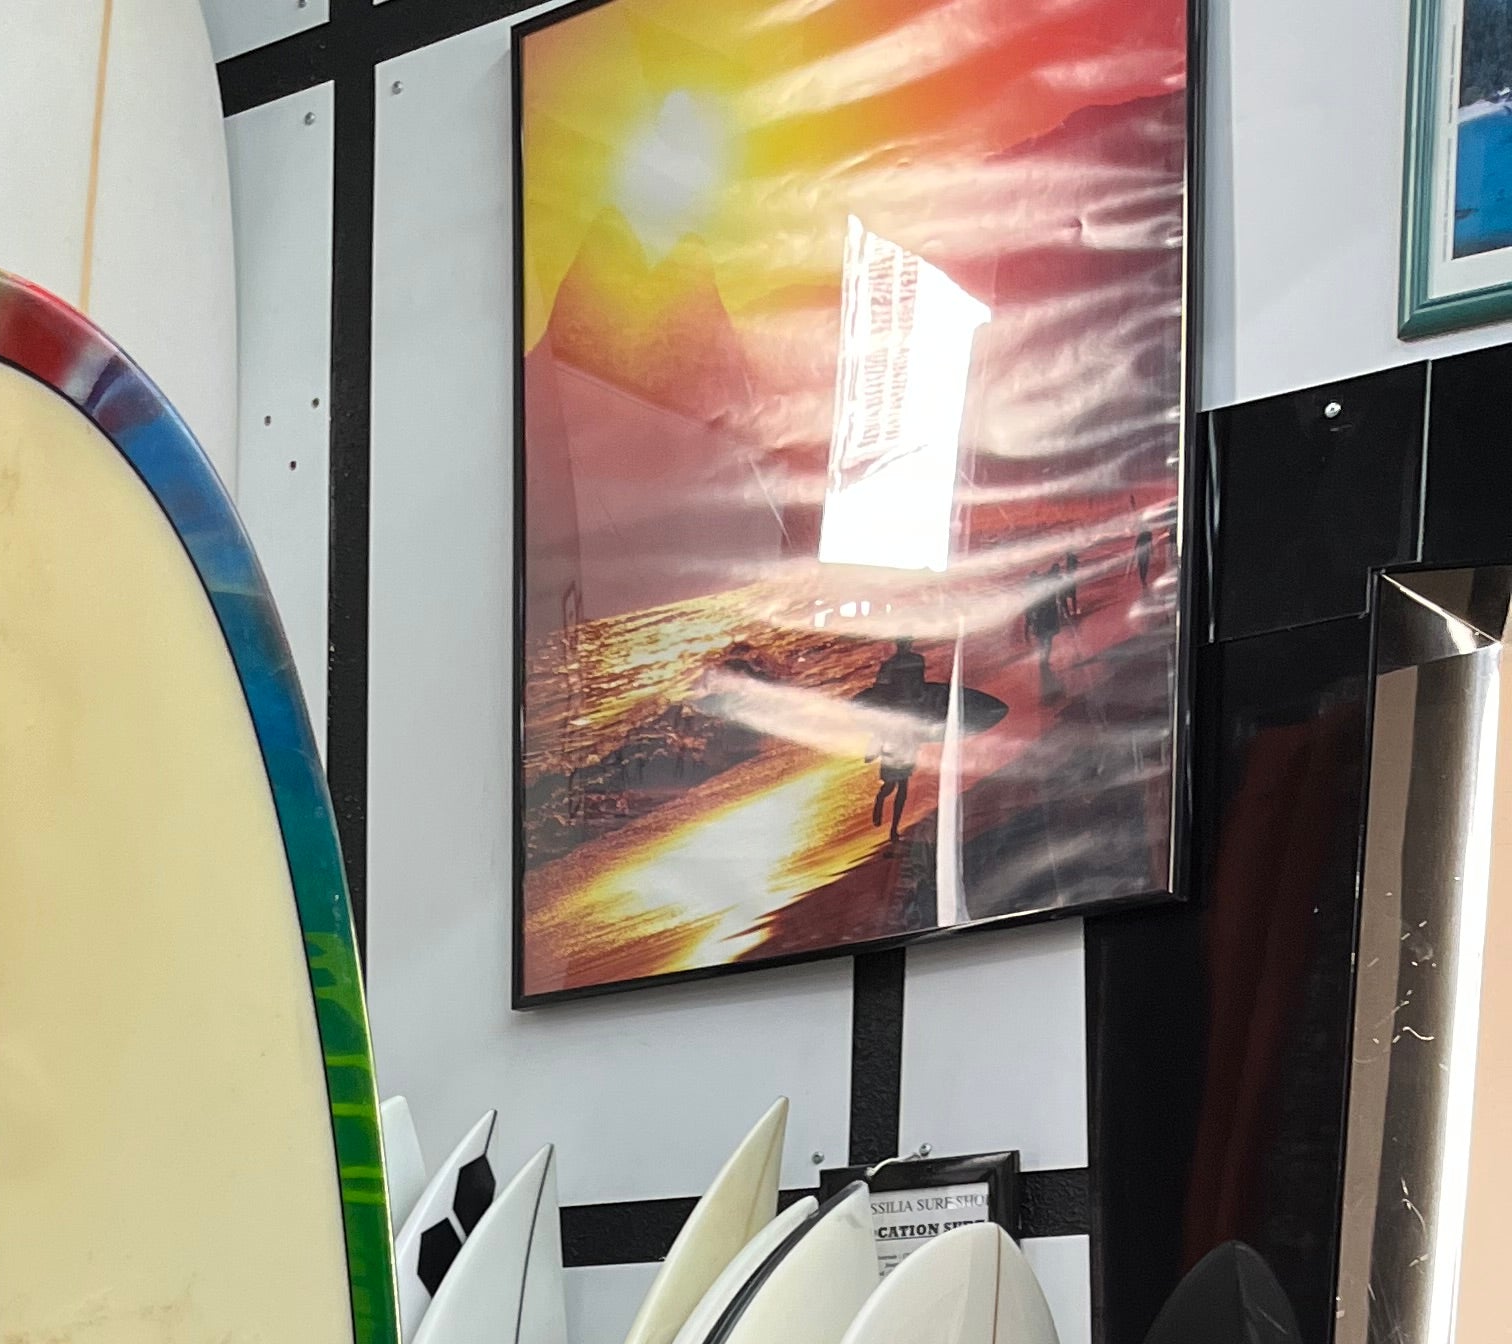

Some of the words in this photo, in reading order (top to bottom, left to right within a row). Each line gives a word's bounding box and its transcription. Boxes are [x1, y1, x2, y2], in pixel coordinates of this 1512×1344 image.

[871, 1201, 913, 1215] SSILIA
[917, 1197, 952, 1211] SURF
[955, 1193, 989, 1209] SHO
[874, 1223, 940, 1239] CATION
